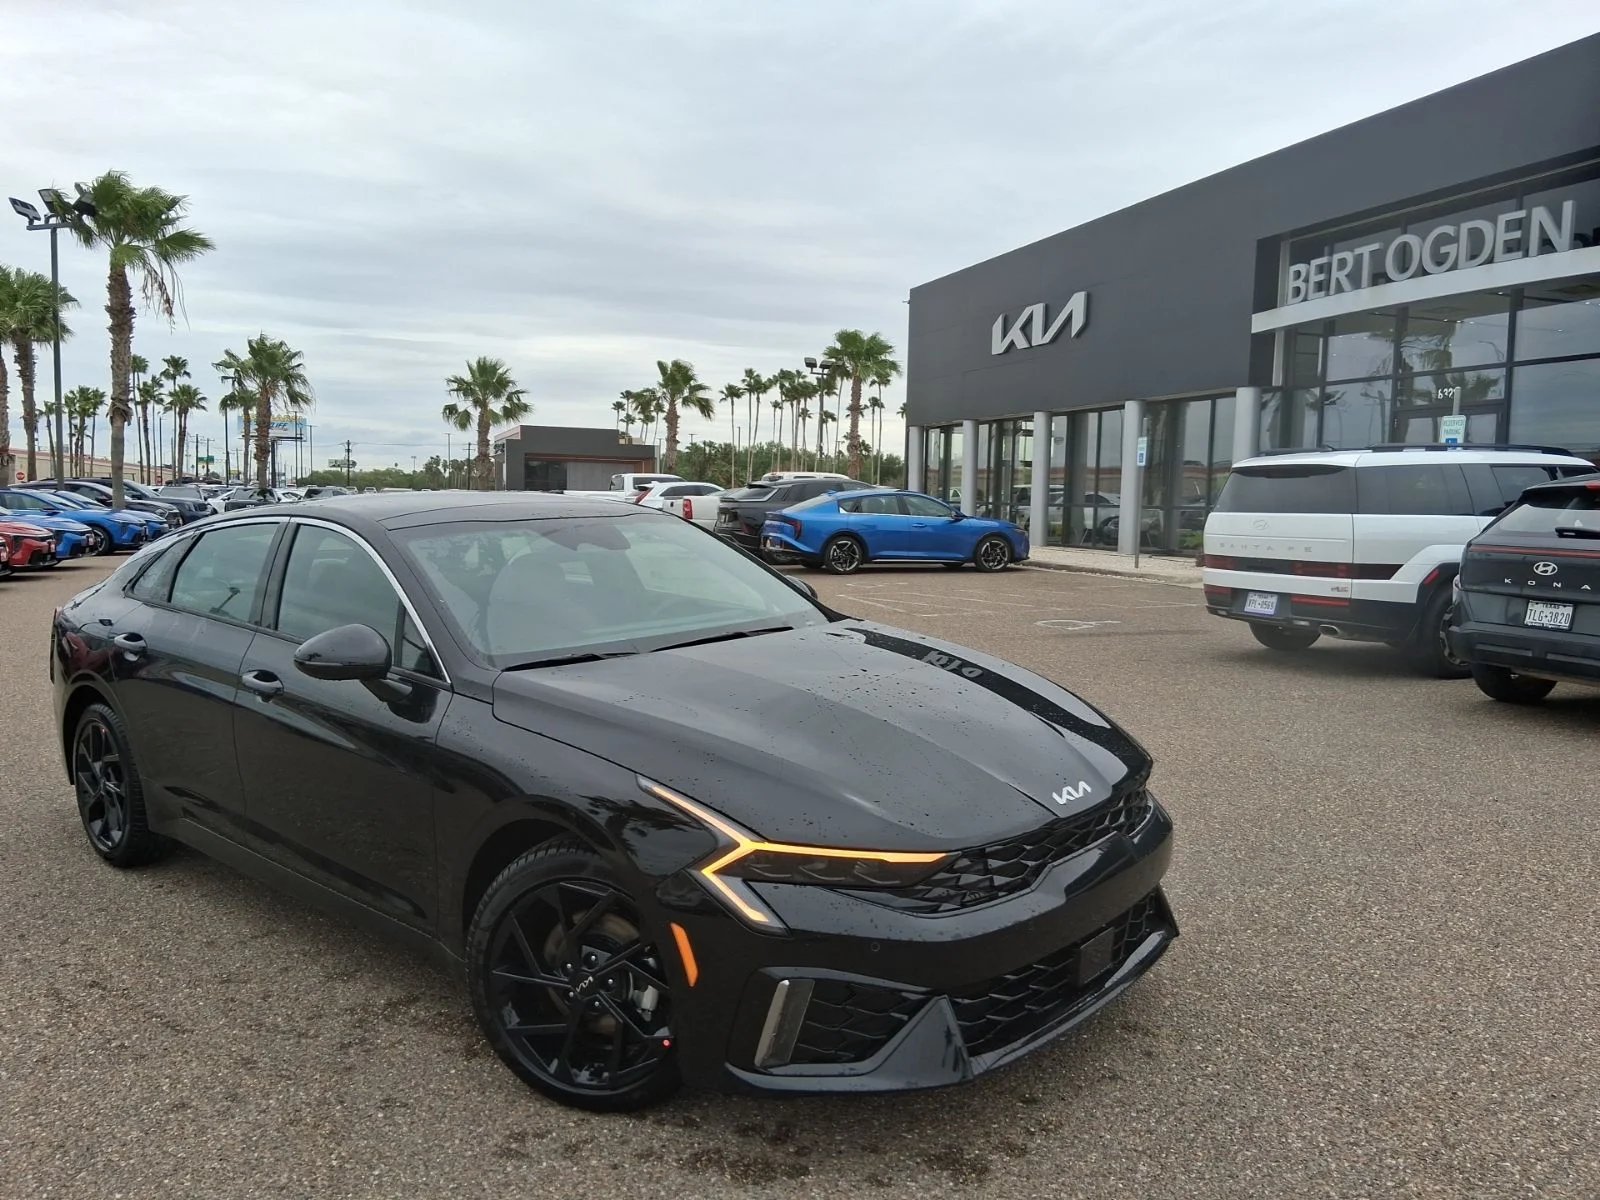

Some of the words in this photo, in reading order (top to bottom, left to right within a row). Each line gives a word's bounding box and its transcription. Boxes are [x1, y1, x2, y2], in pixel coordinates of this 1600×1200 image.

[1287, 242, 1384, 306] BERT
[1385, 199, 1577, 283] OGDEN
[991, 291, 1088, 355] KIA
[1504, 578, 1591, 590] KONA
[1052, 781, 1091, 804] KIA
